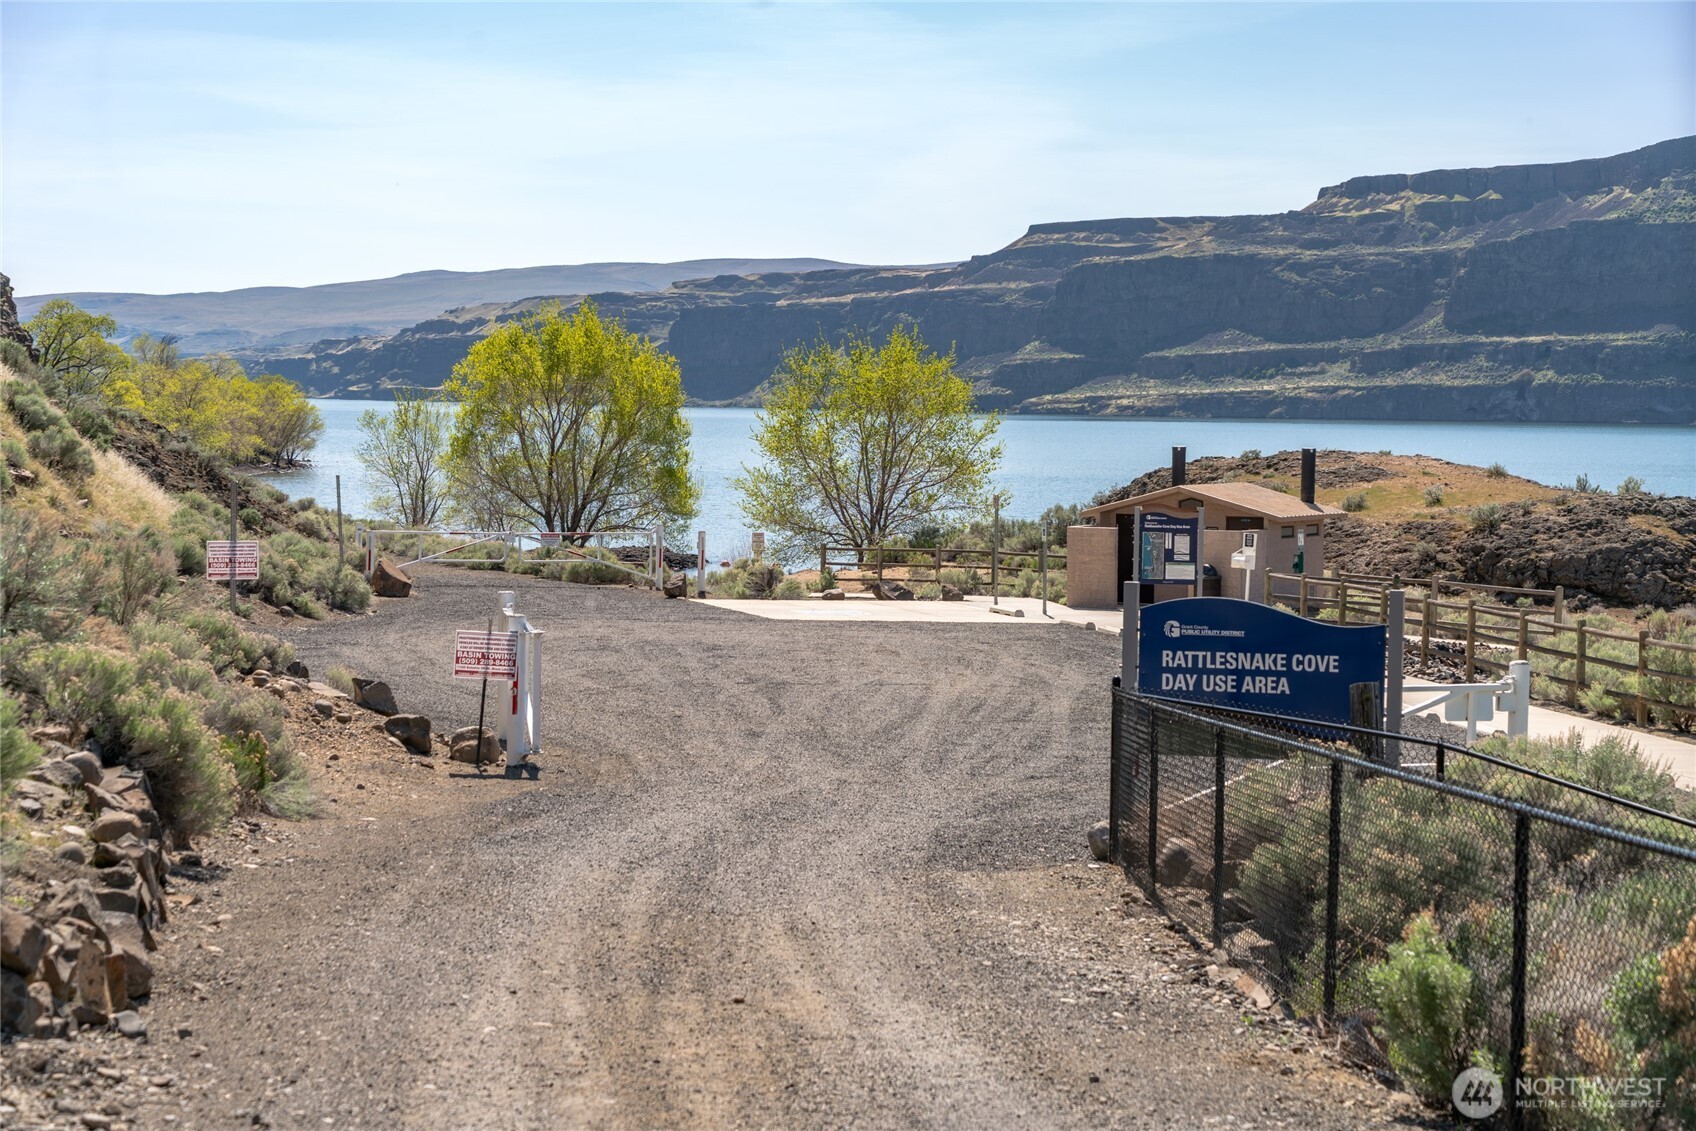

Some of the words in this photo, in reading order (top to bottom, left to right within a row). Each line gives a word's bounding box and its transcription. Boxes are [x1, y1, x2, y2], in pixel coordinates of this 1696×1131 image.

[1162, 650, 1286, 671] RATTLESNAKE
[1292, 654, 1340, 673] COVE
[1162, 673, 1198, 691] DAY
[1202, 674, 1237, 692] USE
[1241, 676, 1290, 694] AREA
